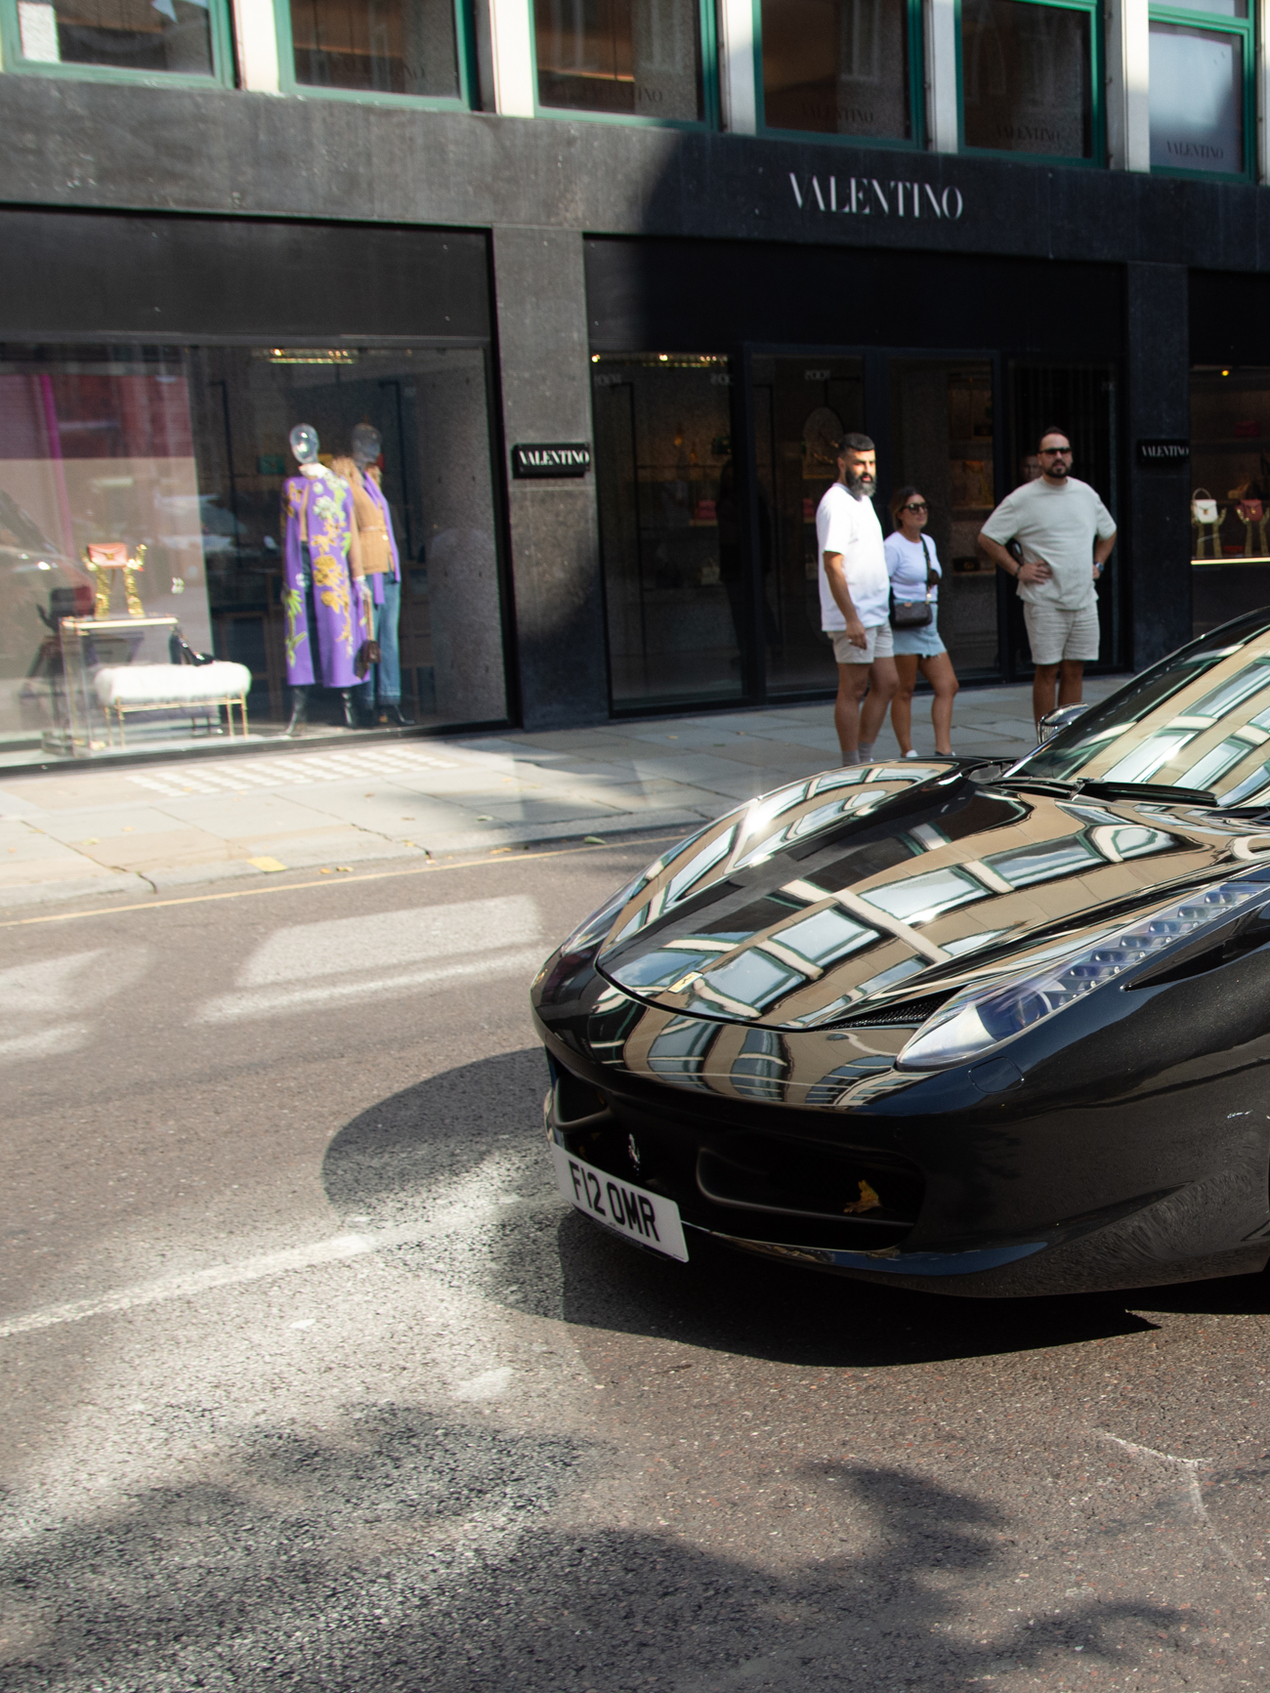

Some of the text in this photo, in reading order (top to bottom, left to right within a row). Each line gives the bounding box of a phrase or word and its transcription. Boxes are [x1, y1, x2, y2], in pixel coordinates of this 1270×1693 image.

[789, 172, 963, 220] VALENTINO
[519, 450, 590, 466] VALENTINO
[1141, 445, 1190, 458] VALENTINO
[568, 1159, 606, 1217] F12
[606, 1181, 661, 1242] OMR
